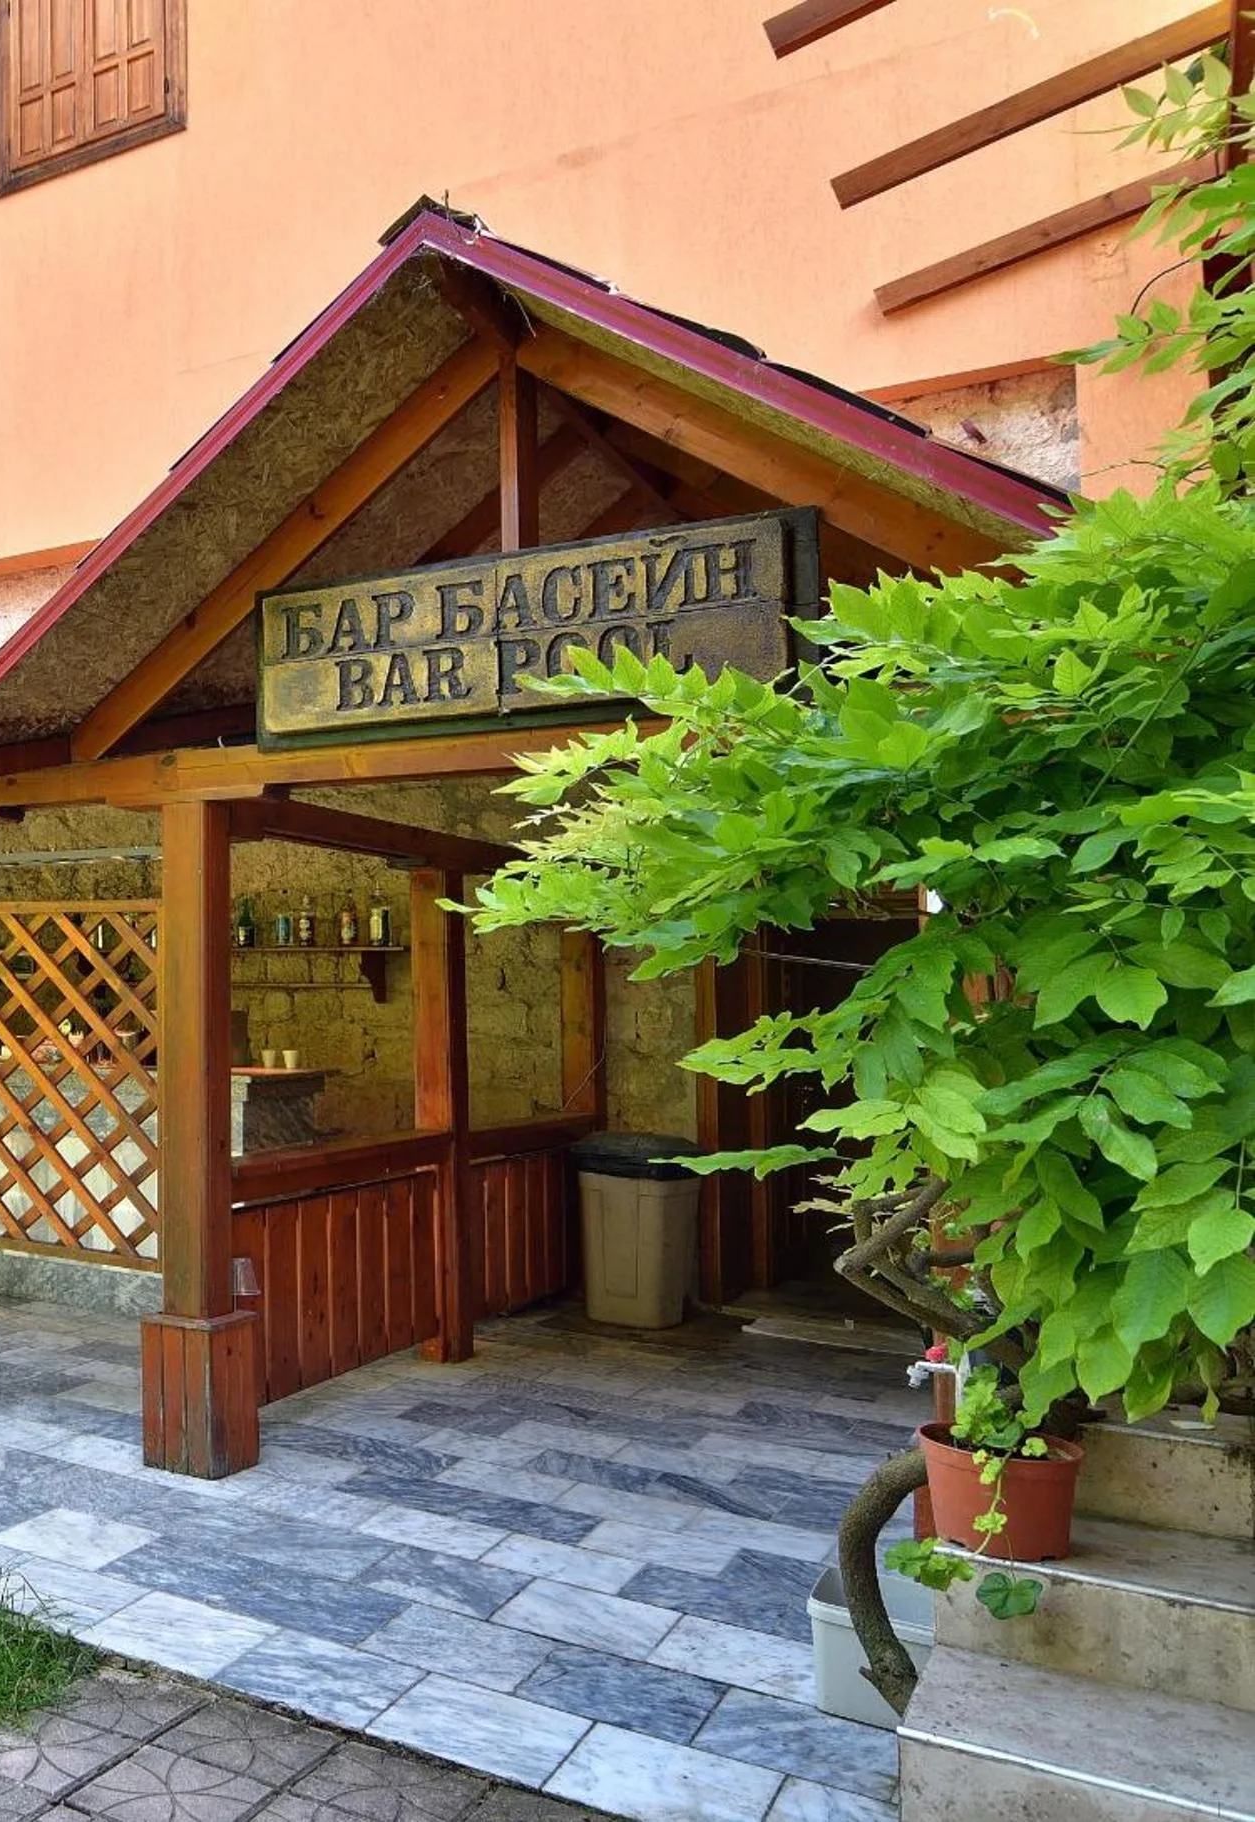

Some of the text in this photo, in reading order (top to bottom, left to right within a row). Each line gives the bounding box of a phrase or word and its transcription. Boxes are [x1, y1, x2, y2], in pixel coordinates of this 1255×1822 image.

[281, 536, 758, 659] БАР БАСЕЙН
[335, 647, 474, 711] BAR
